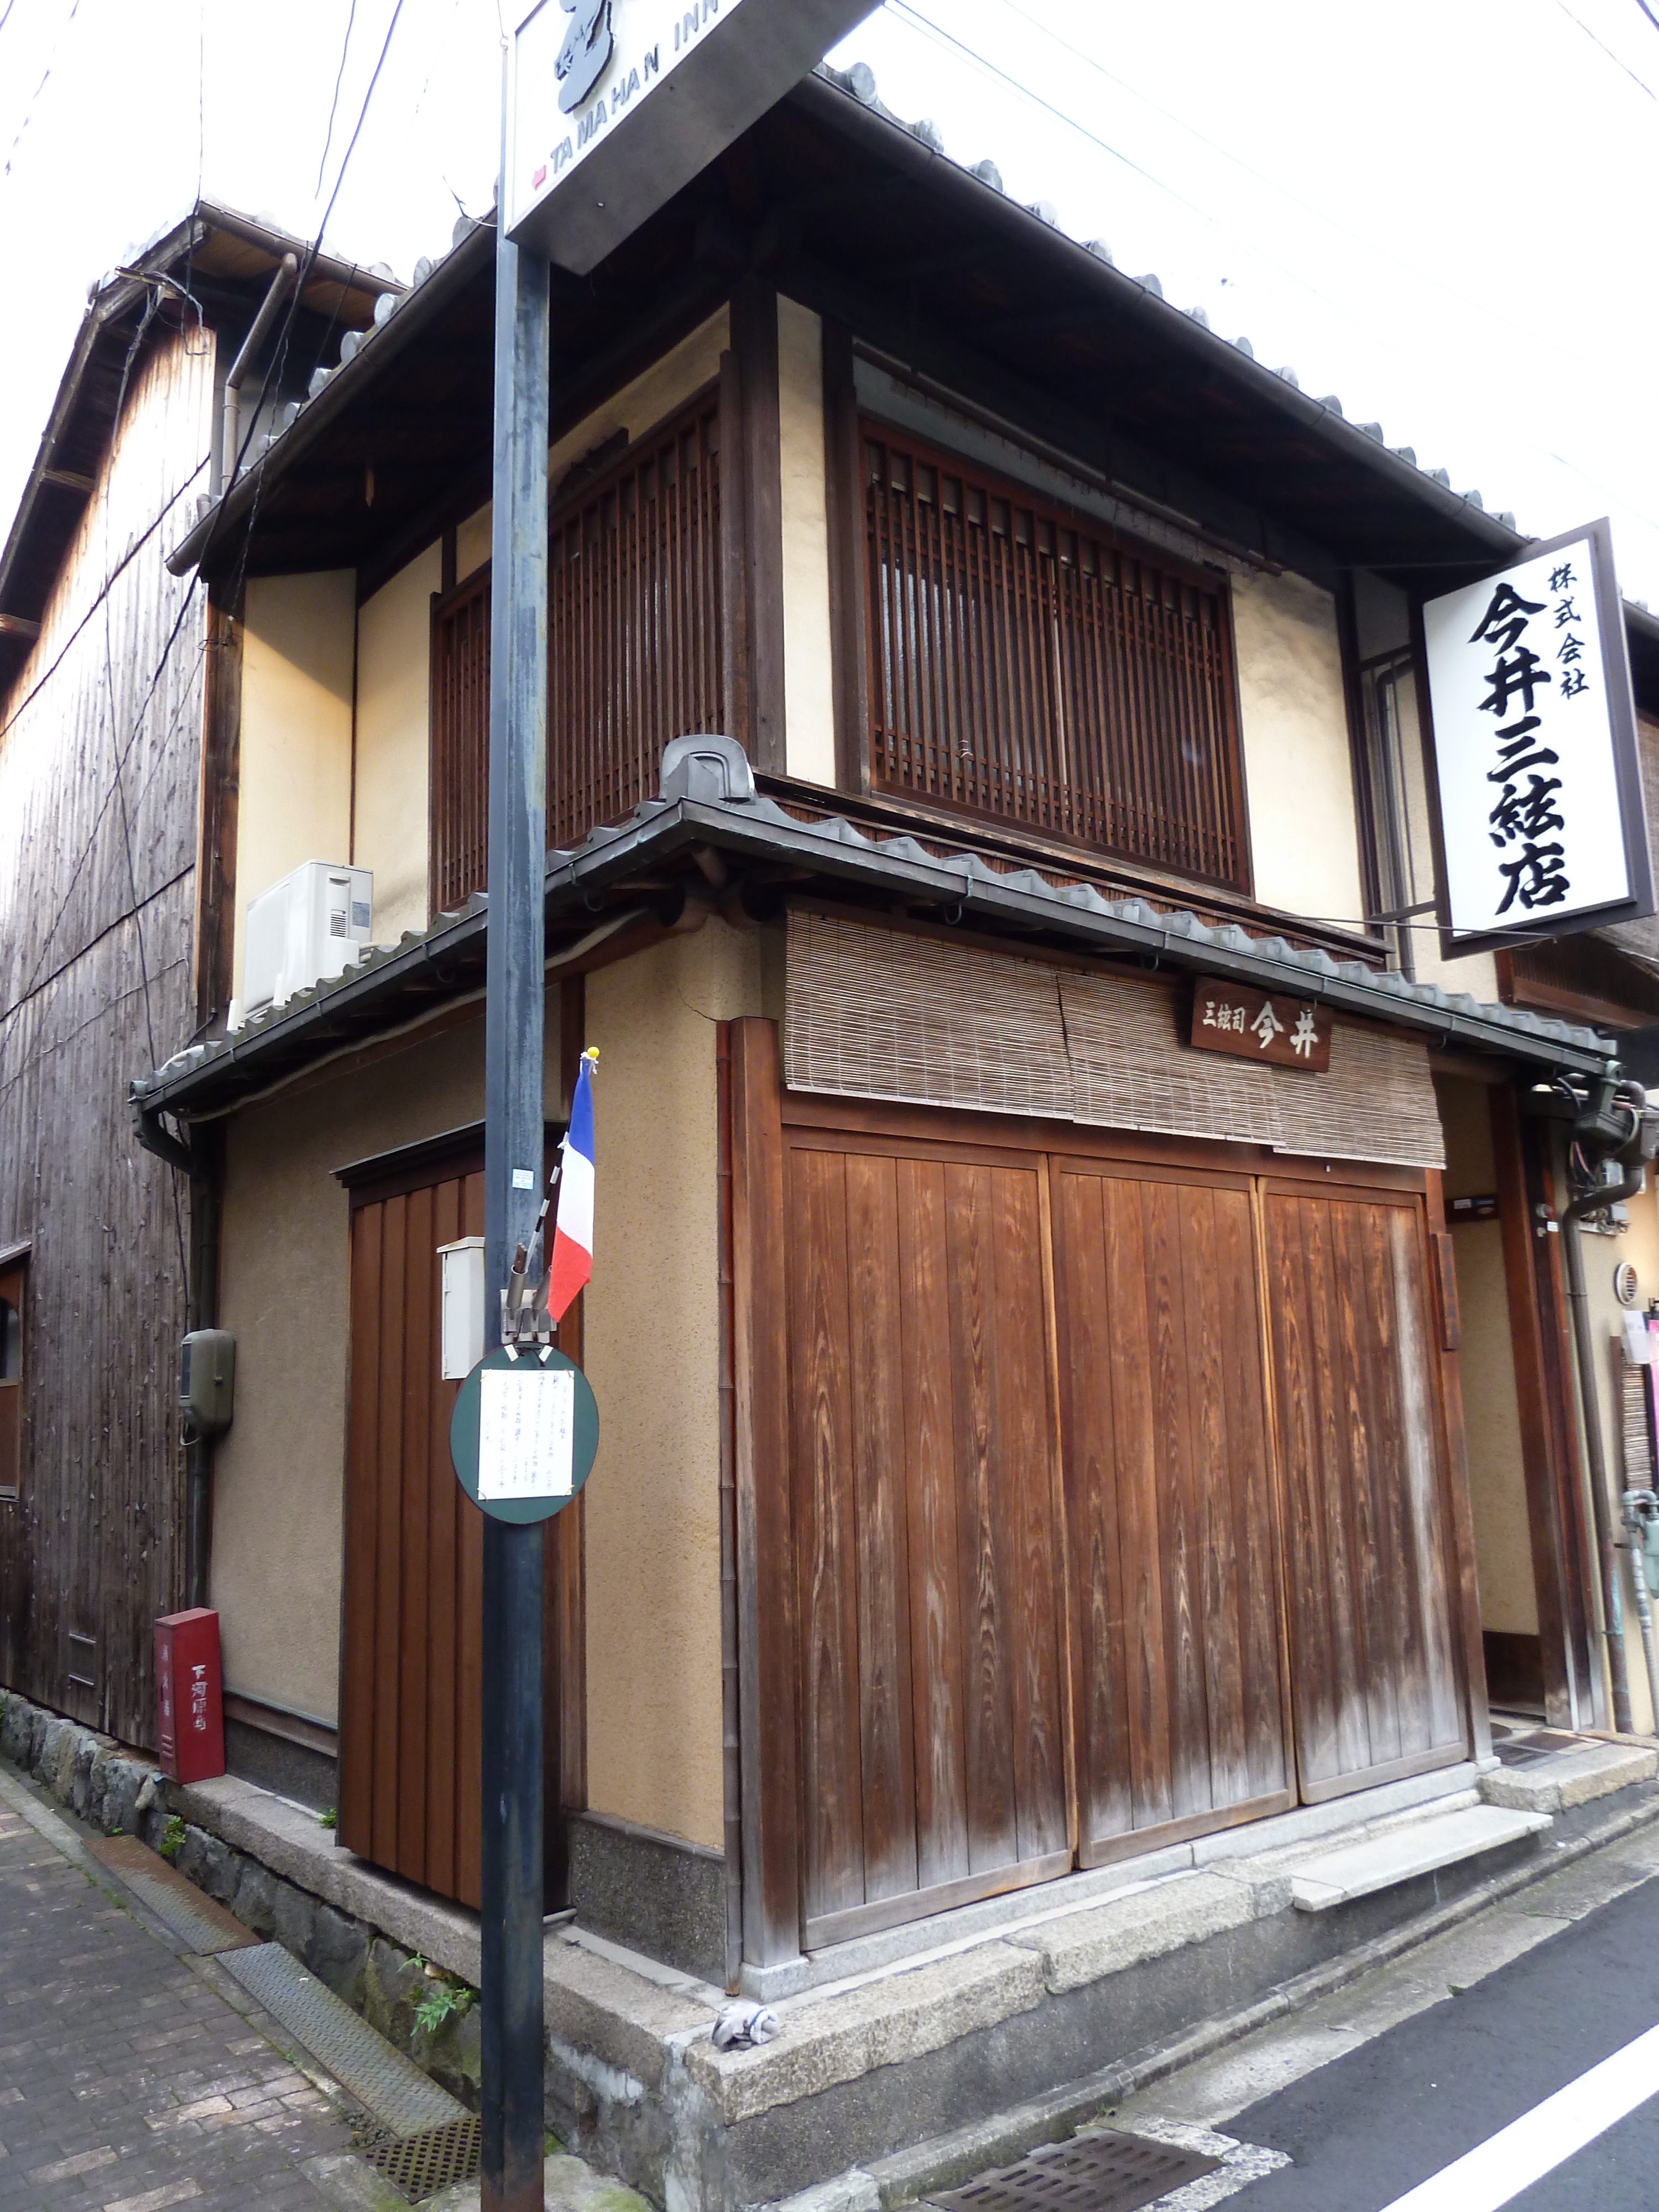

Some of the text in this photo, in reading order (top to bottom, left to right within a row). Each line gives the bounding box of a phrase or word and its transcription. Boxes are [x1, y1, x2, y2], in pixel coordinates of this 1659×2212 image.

[1548, 563, 1590, 701] 株式会社
[1467, 582, 1571, 916] 今井三絃店
[1250, 1001, 1319, 1058] 今井
